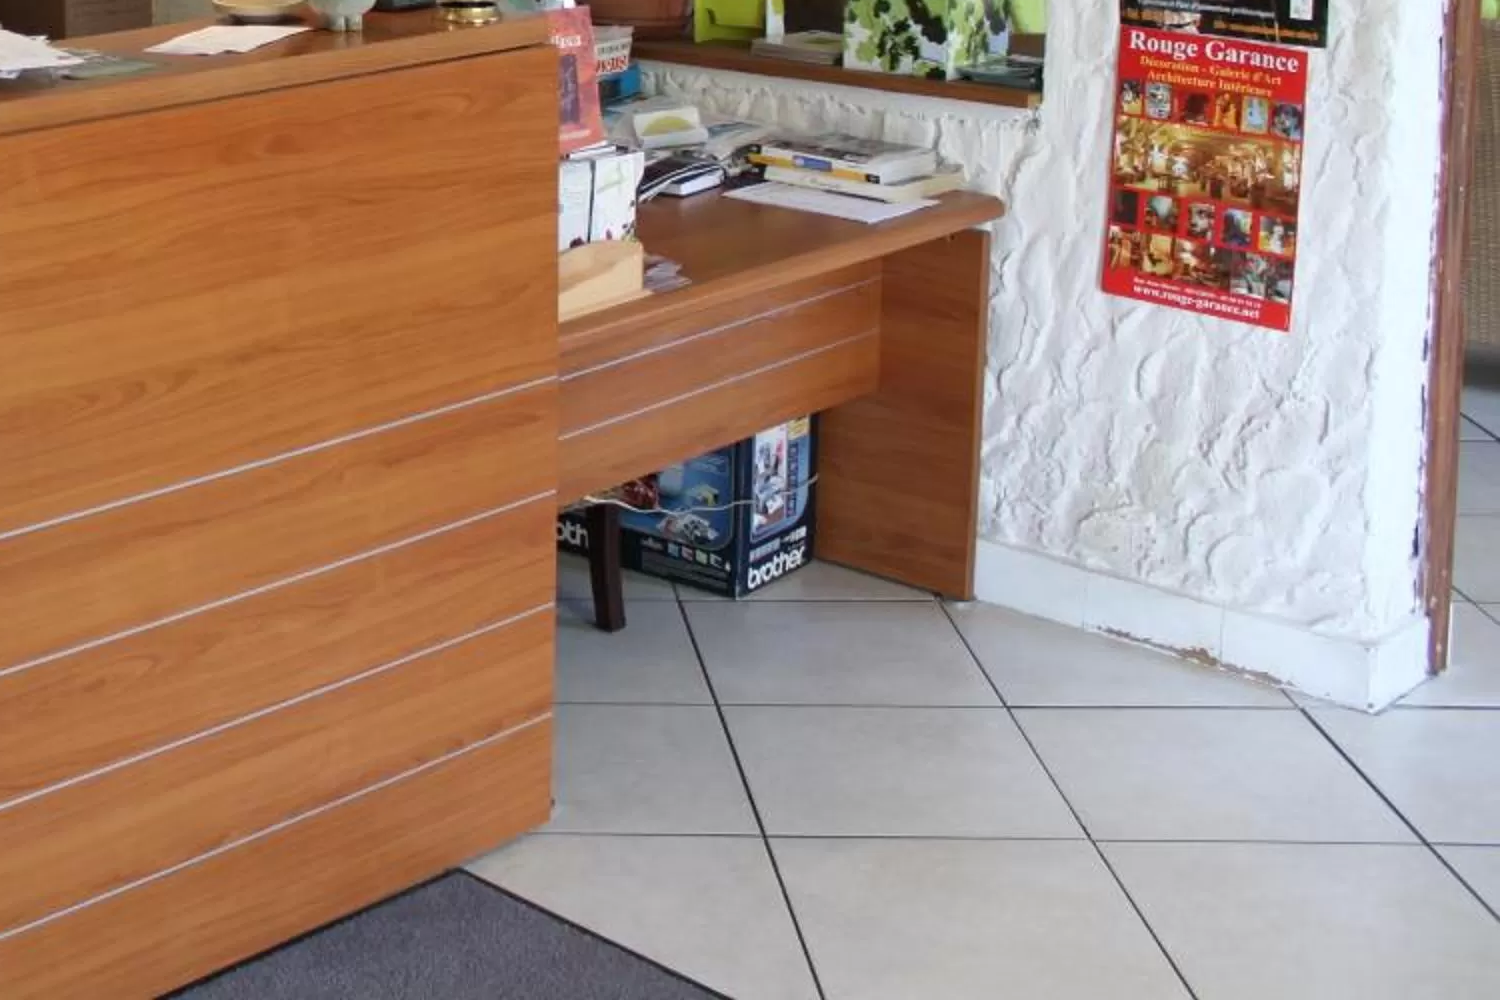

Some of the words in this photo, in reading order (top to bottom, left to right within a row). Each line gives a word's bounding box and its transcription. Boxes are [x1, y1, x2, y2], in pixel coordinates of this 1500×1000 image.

[1129, 29, 1198, 61] Rouge
[1205, 40, 1299, 73] Garance
[1140, 55, 1199, 73] Décoration
[1209, 65, 1251, 81] Galerie
[1147, 70, 1216, 89] Architecture
[747, 545, 805, 589] brother
